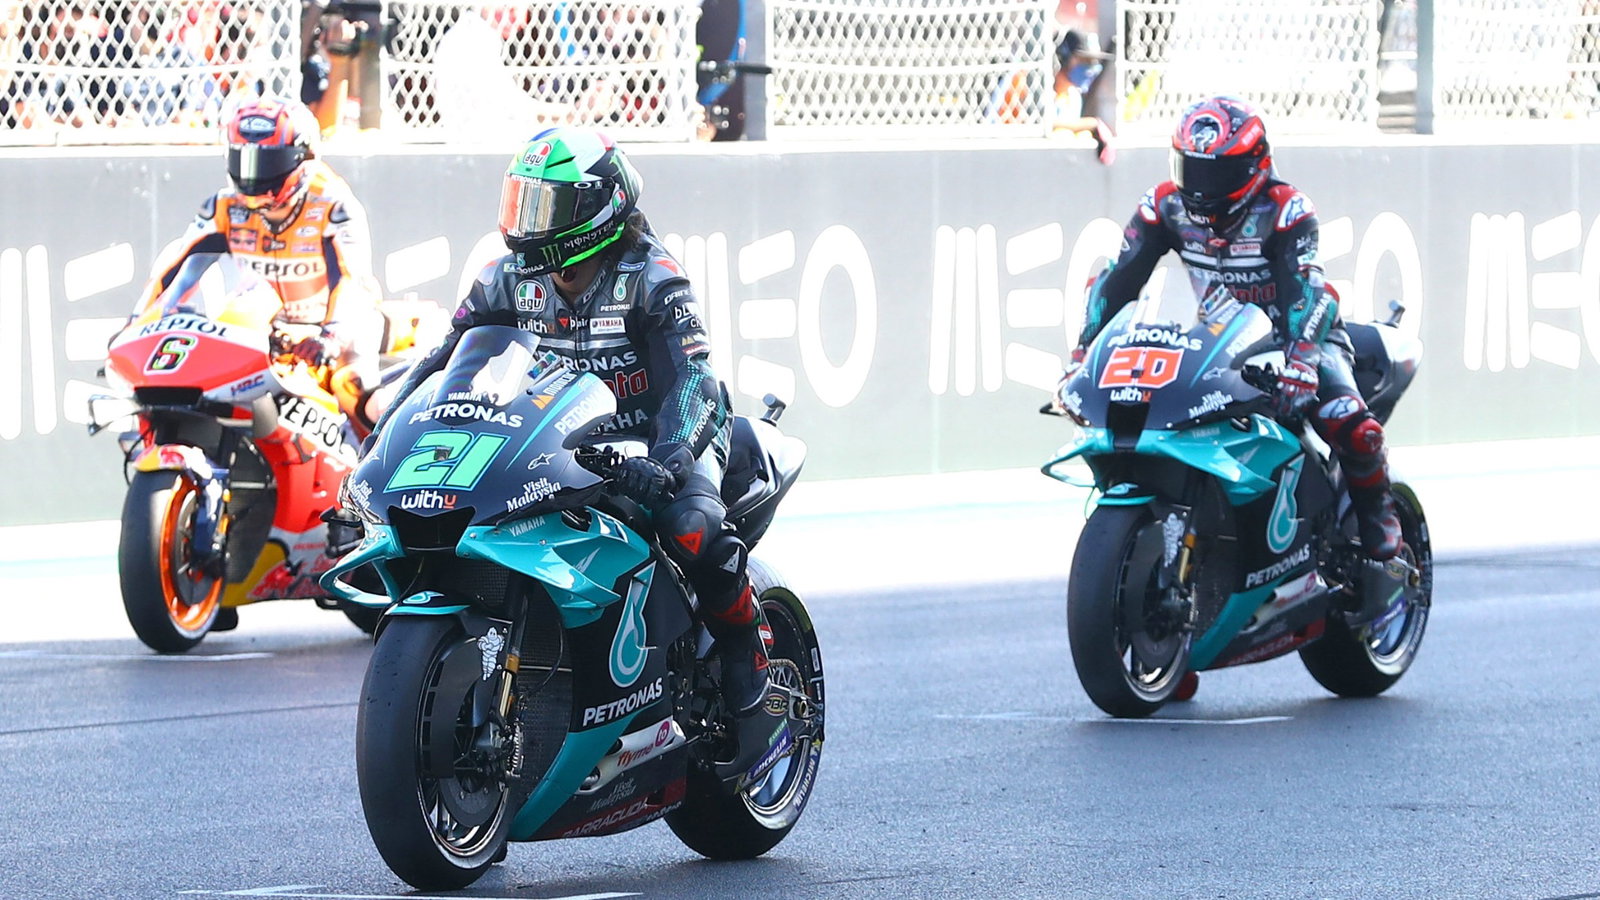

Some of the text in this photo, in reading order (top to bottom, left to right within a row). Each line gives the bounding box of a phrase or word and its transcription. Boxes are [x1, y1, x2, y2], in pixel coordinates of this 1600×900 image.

[524, 154, 543, 165] agv
[564, 220, 615, 249] MONSTER
[519, 298, 542, 310] agv
[1463, 210, 1600, 373] ME
[140, 317, 228, 337] REPSOL
[1107, 328, 1204, 351] PETRONAS
[1098, 346, 1184, 388] 20
[231, 374, 265, 396] HRC
[447, 391, 482, 402] YAMAHA
[408, 403, 524, 428] PETRONAS
[689, 399, 717, 447] PETRONAS
[383, 429, 511, 492] 21
[506, 482, 562, 513] Malaysia
[523, 477, 549, 493] Visit
[400, 489, 457, 509] withu
[509, 515, 546, 537] YAMAHA
[1245, 543, 1310, 588] PETRONAS
[583, 677, 663, 727] PETRONAS
[793, 758, 816, 807] MICHELIN
